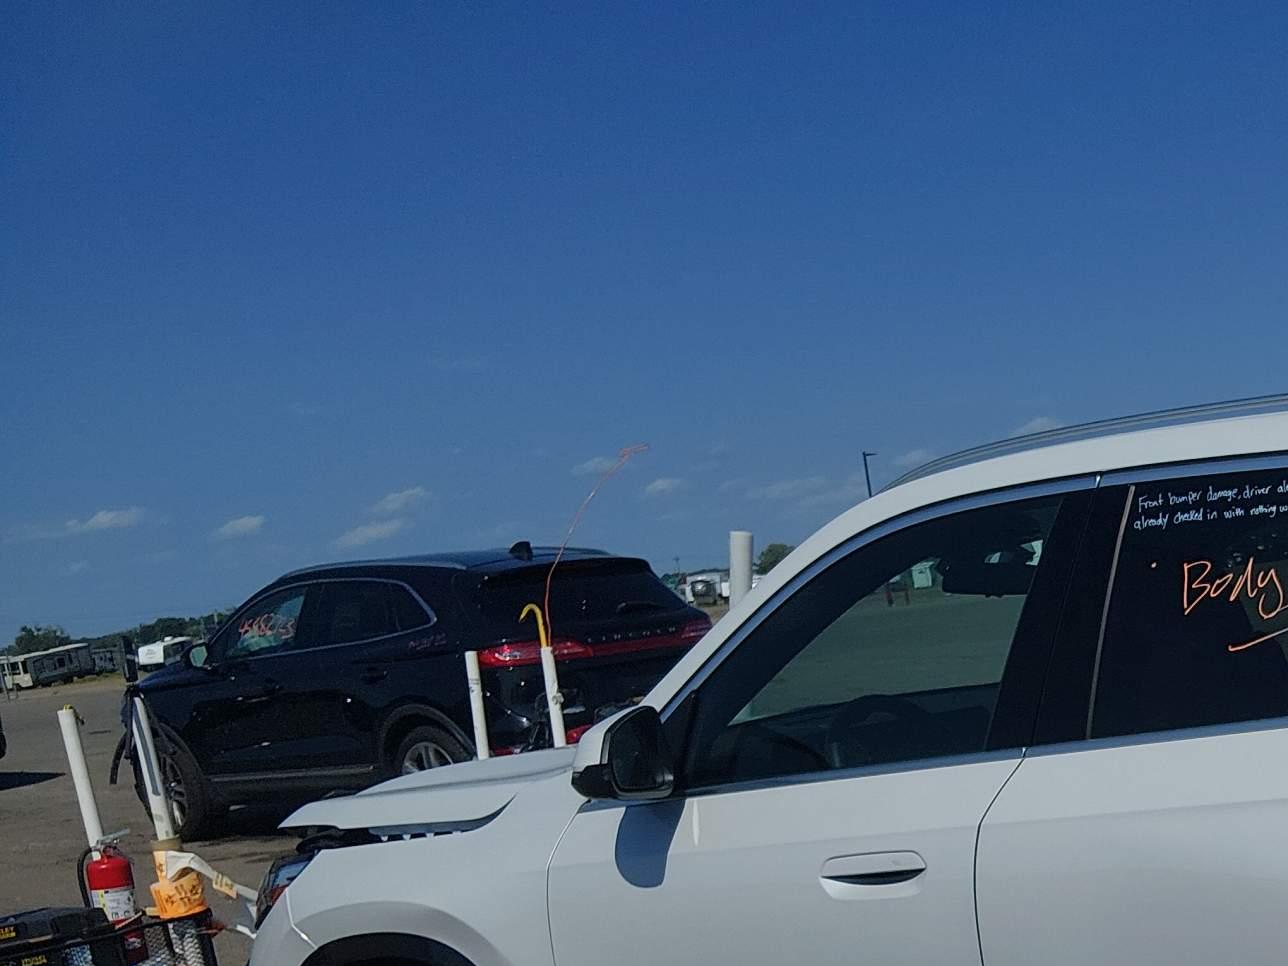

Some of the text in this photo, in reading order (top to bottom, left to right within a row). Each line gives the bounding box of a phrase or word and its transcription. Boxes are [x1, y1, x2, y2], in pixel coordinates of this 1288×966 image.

[1138, 494, 1164, 512] Front
[1168, 491, 1202, 504] bumper
[1243, 485, 1272, 499] driver
[1134, 513, 1169, 530] already
[1174, 508, 1203, 524] checked
[1207, 509, 1218, 520] in
[1224, 506, 1245, 519] with
[1250, 504, 1277, 518] nothing
[1183, 557, 1284, 619] Body
